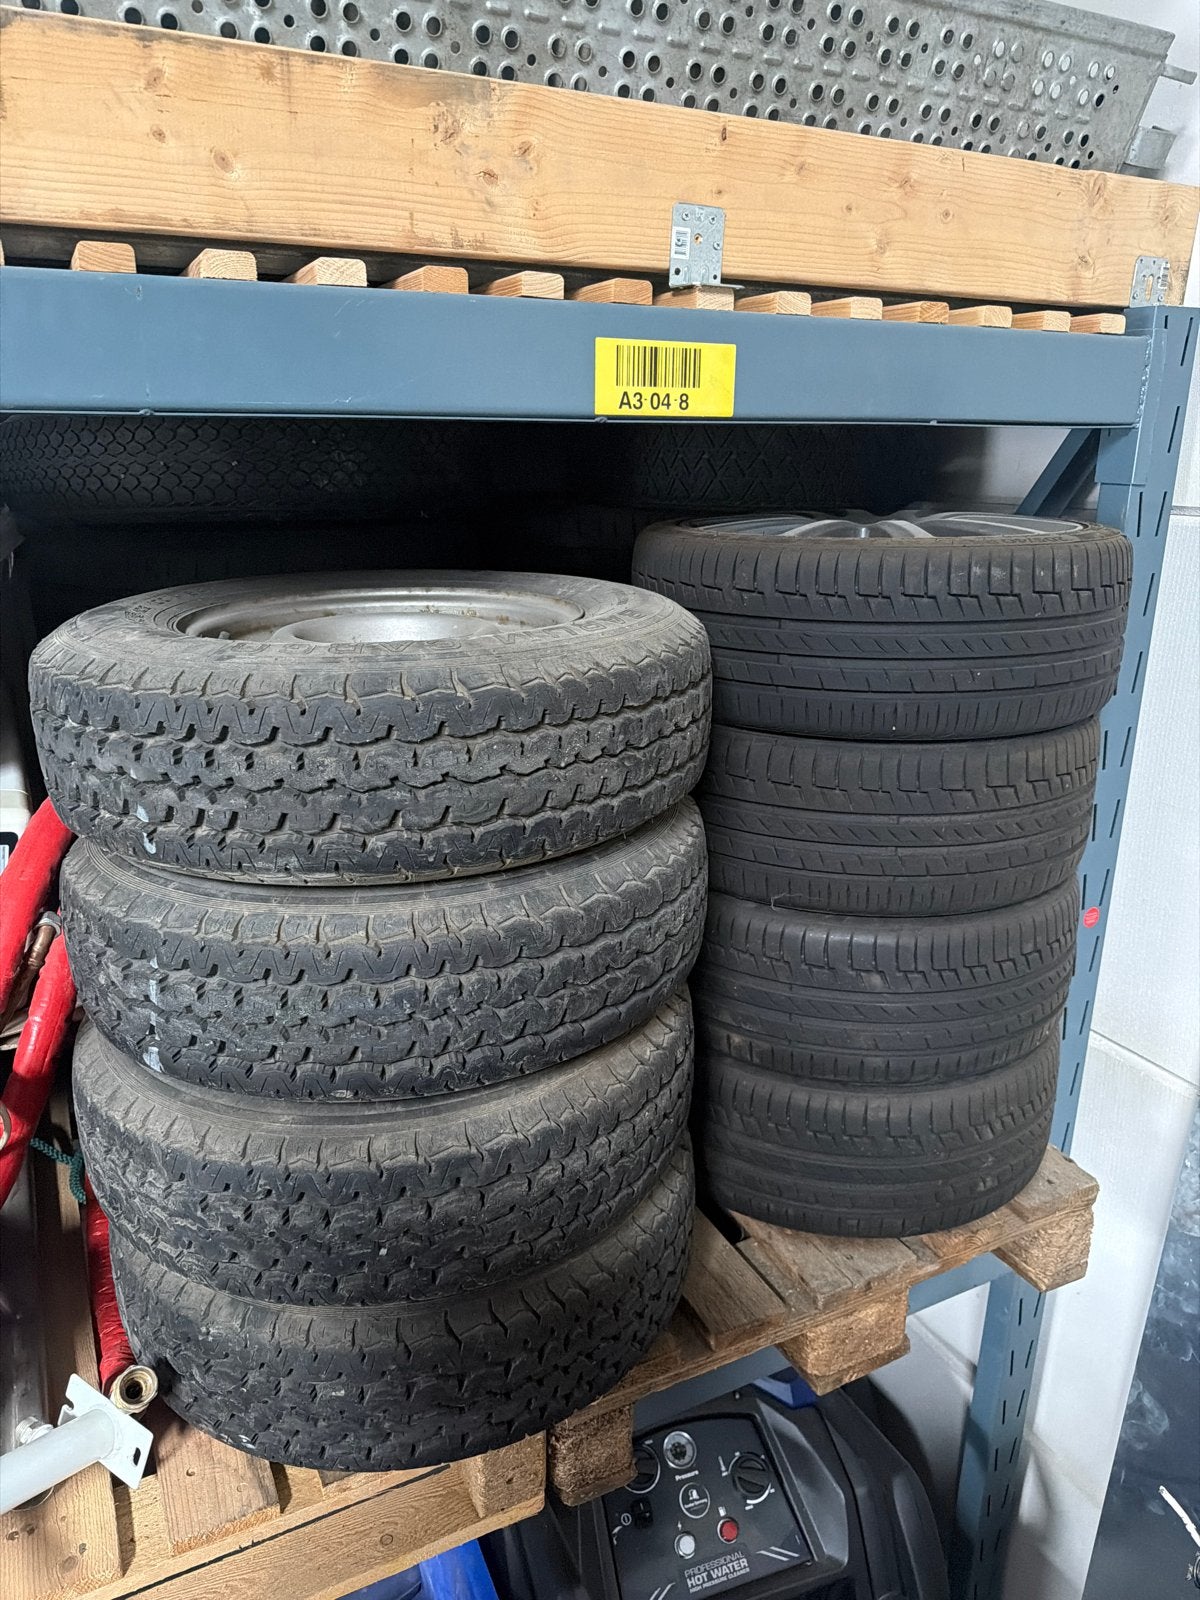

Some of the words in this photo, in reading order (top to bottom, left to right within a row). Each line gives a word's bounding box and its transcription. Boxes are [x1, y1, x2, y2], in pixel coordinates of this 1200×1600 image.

[684, 1551, 745, 1578] PROFESSIONAL
[686, 1572, 709, 1588] HOT
[710, 1558, 749, 1580] WATER
